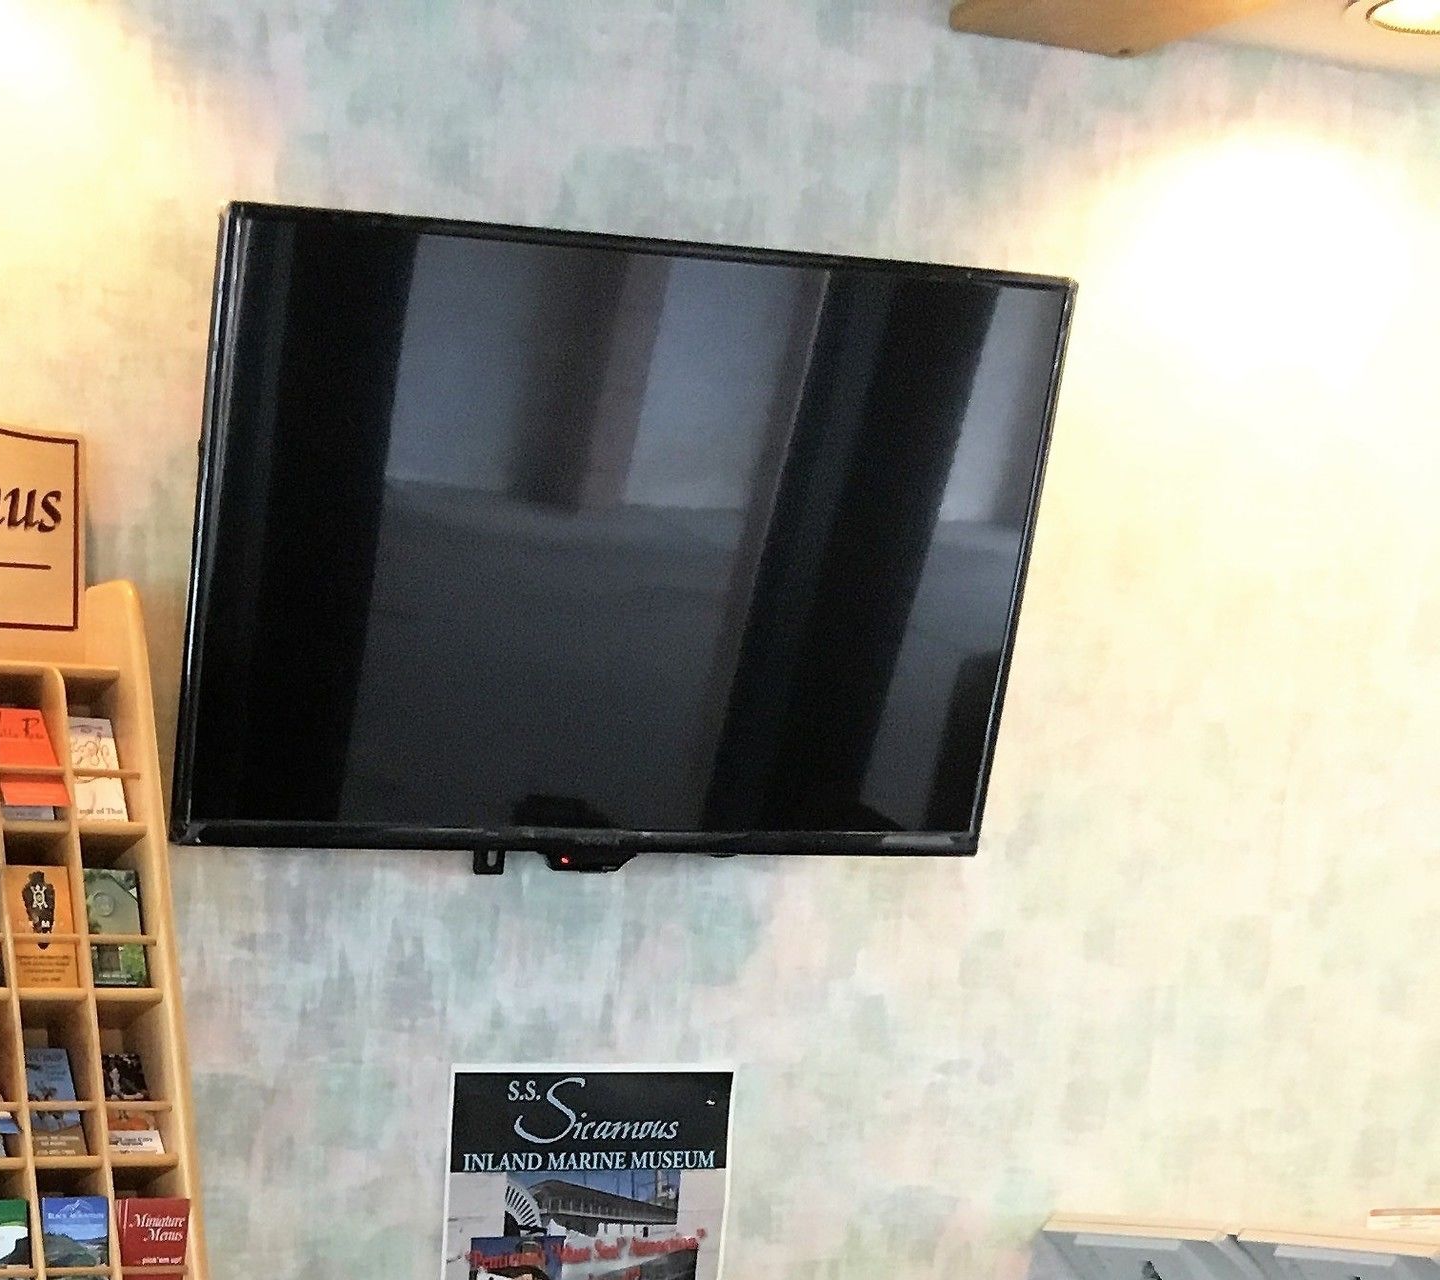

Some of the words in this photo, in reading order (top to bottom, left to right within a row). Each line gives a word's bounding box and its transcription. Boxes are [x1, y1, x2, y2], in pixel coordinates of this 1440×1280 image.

[507, 1080, 541, 1101] S.S.
[513, 1077, 679, 1144] Sicamous
[463, 1152, 542, 1171] INLAND
[547, 1151, 626, 1171] MARINE
[631, 1149, 715, 1170] MUSEUM
[128, 1213, 186, 1229] Miniature
[142, 1226, 184, 1243] Menus
